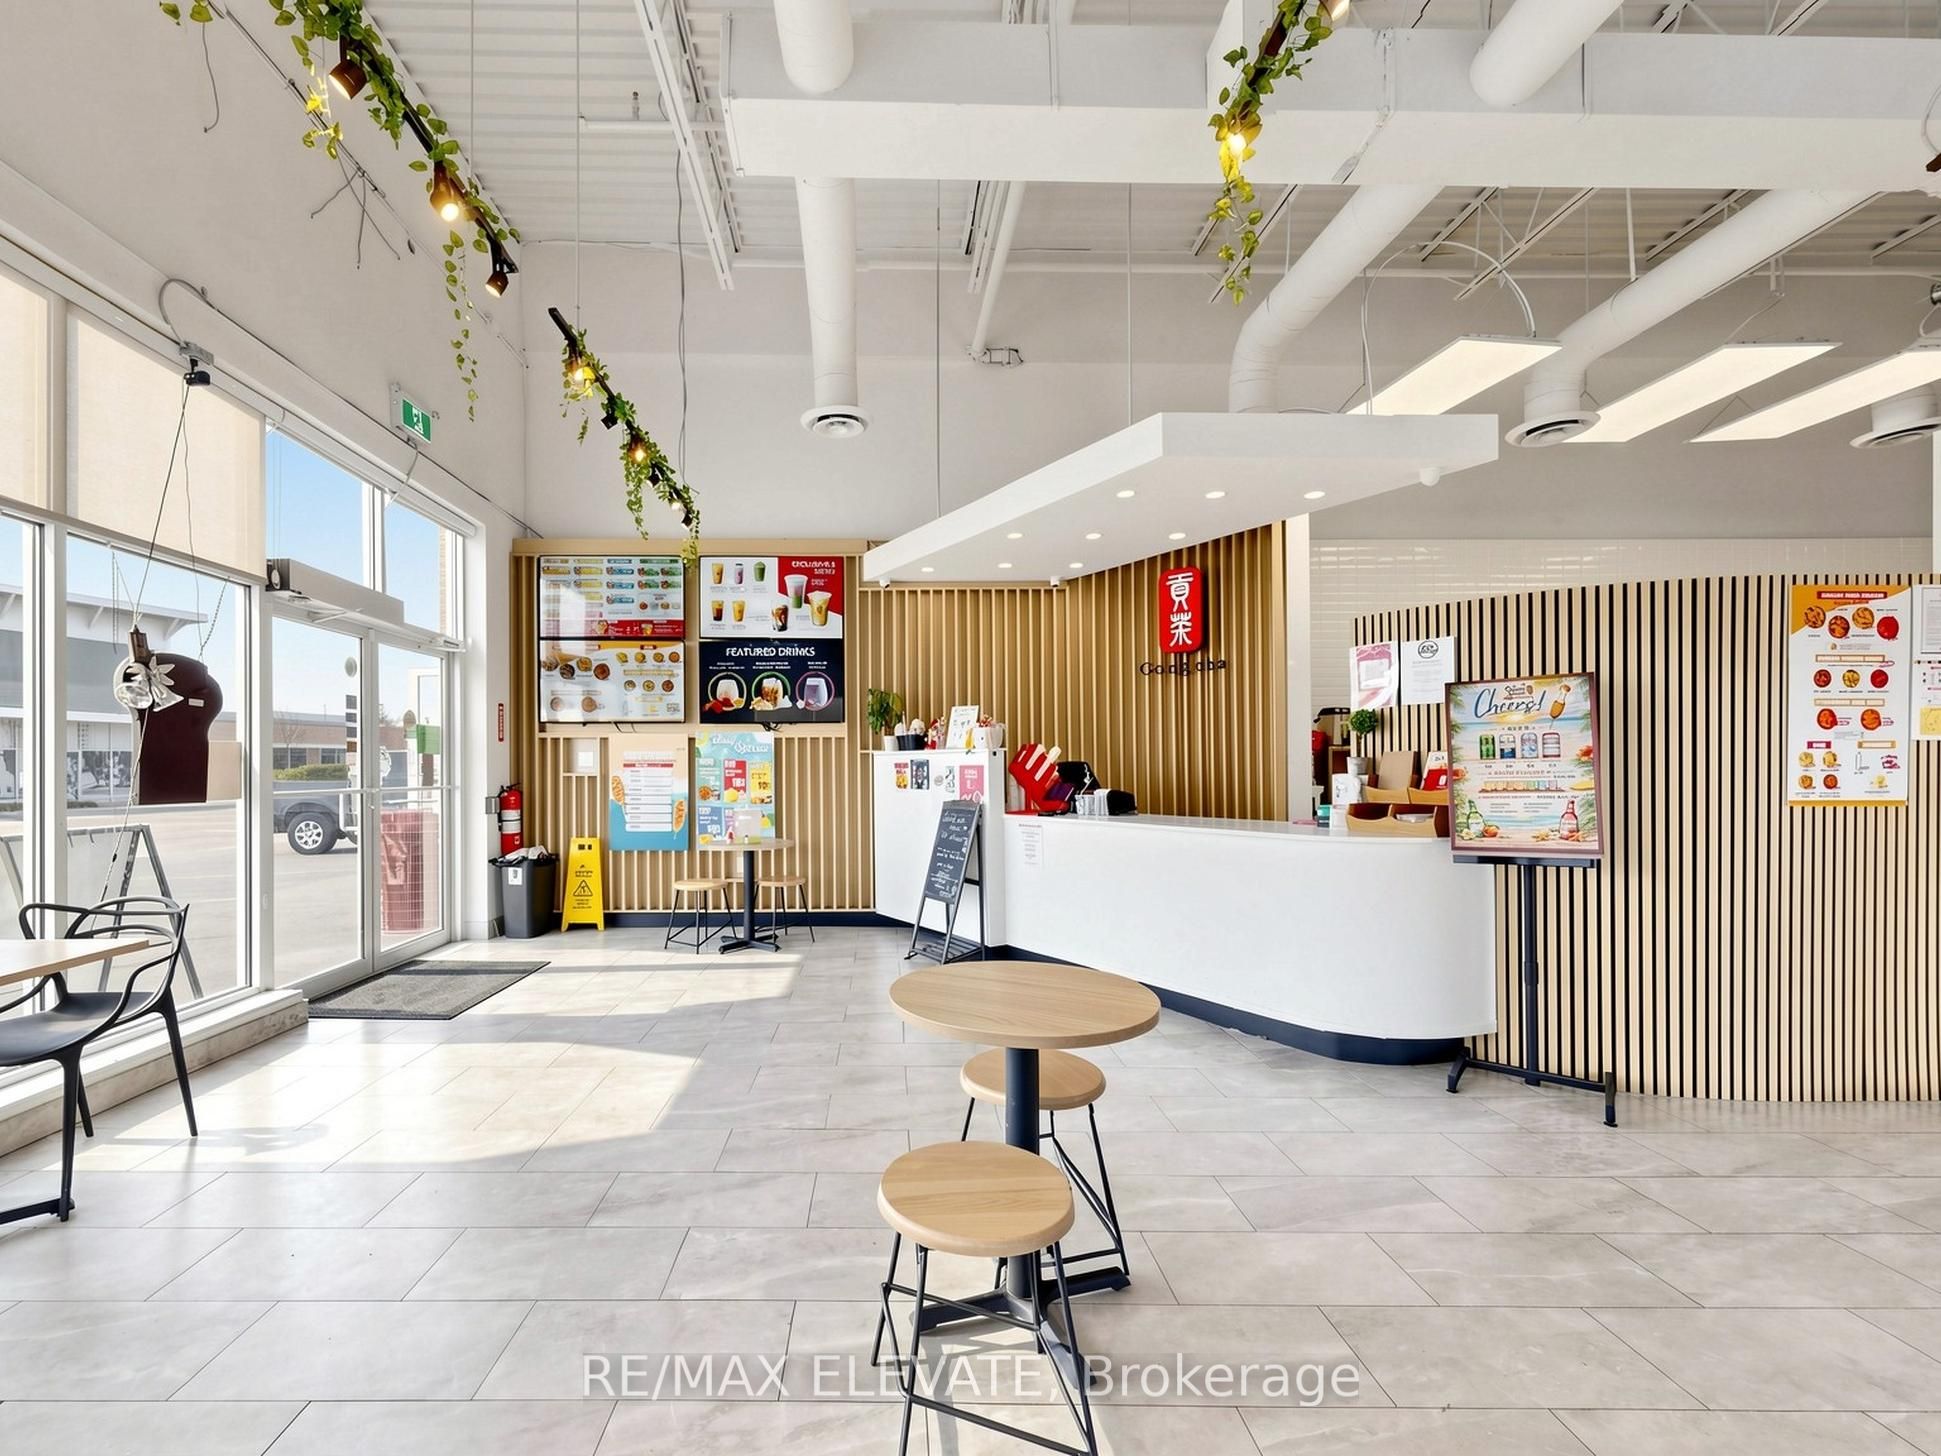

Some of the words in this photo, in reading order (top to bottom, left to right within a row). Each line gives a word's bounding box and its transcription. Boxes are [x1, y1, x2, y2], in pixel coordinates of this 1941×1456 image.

[726, 647, 776, 657] FEATURED
[778, 647, 816, 657] DRINKS
[1474, 687, 1547, 719] Cheers!
